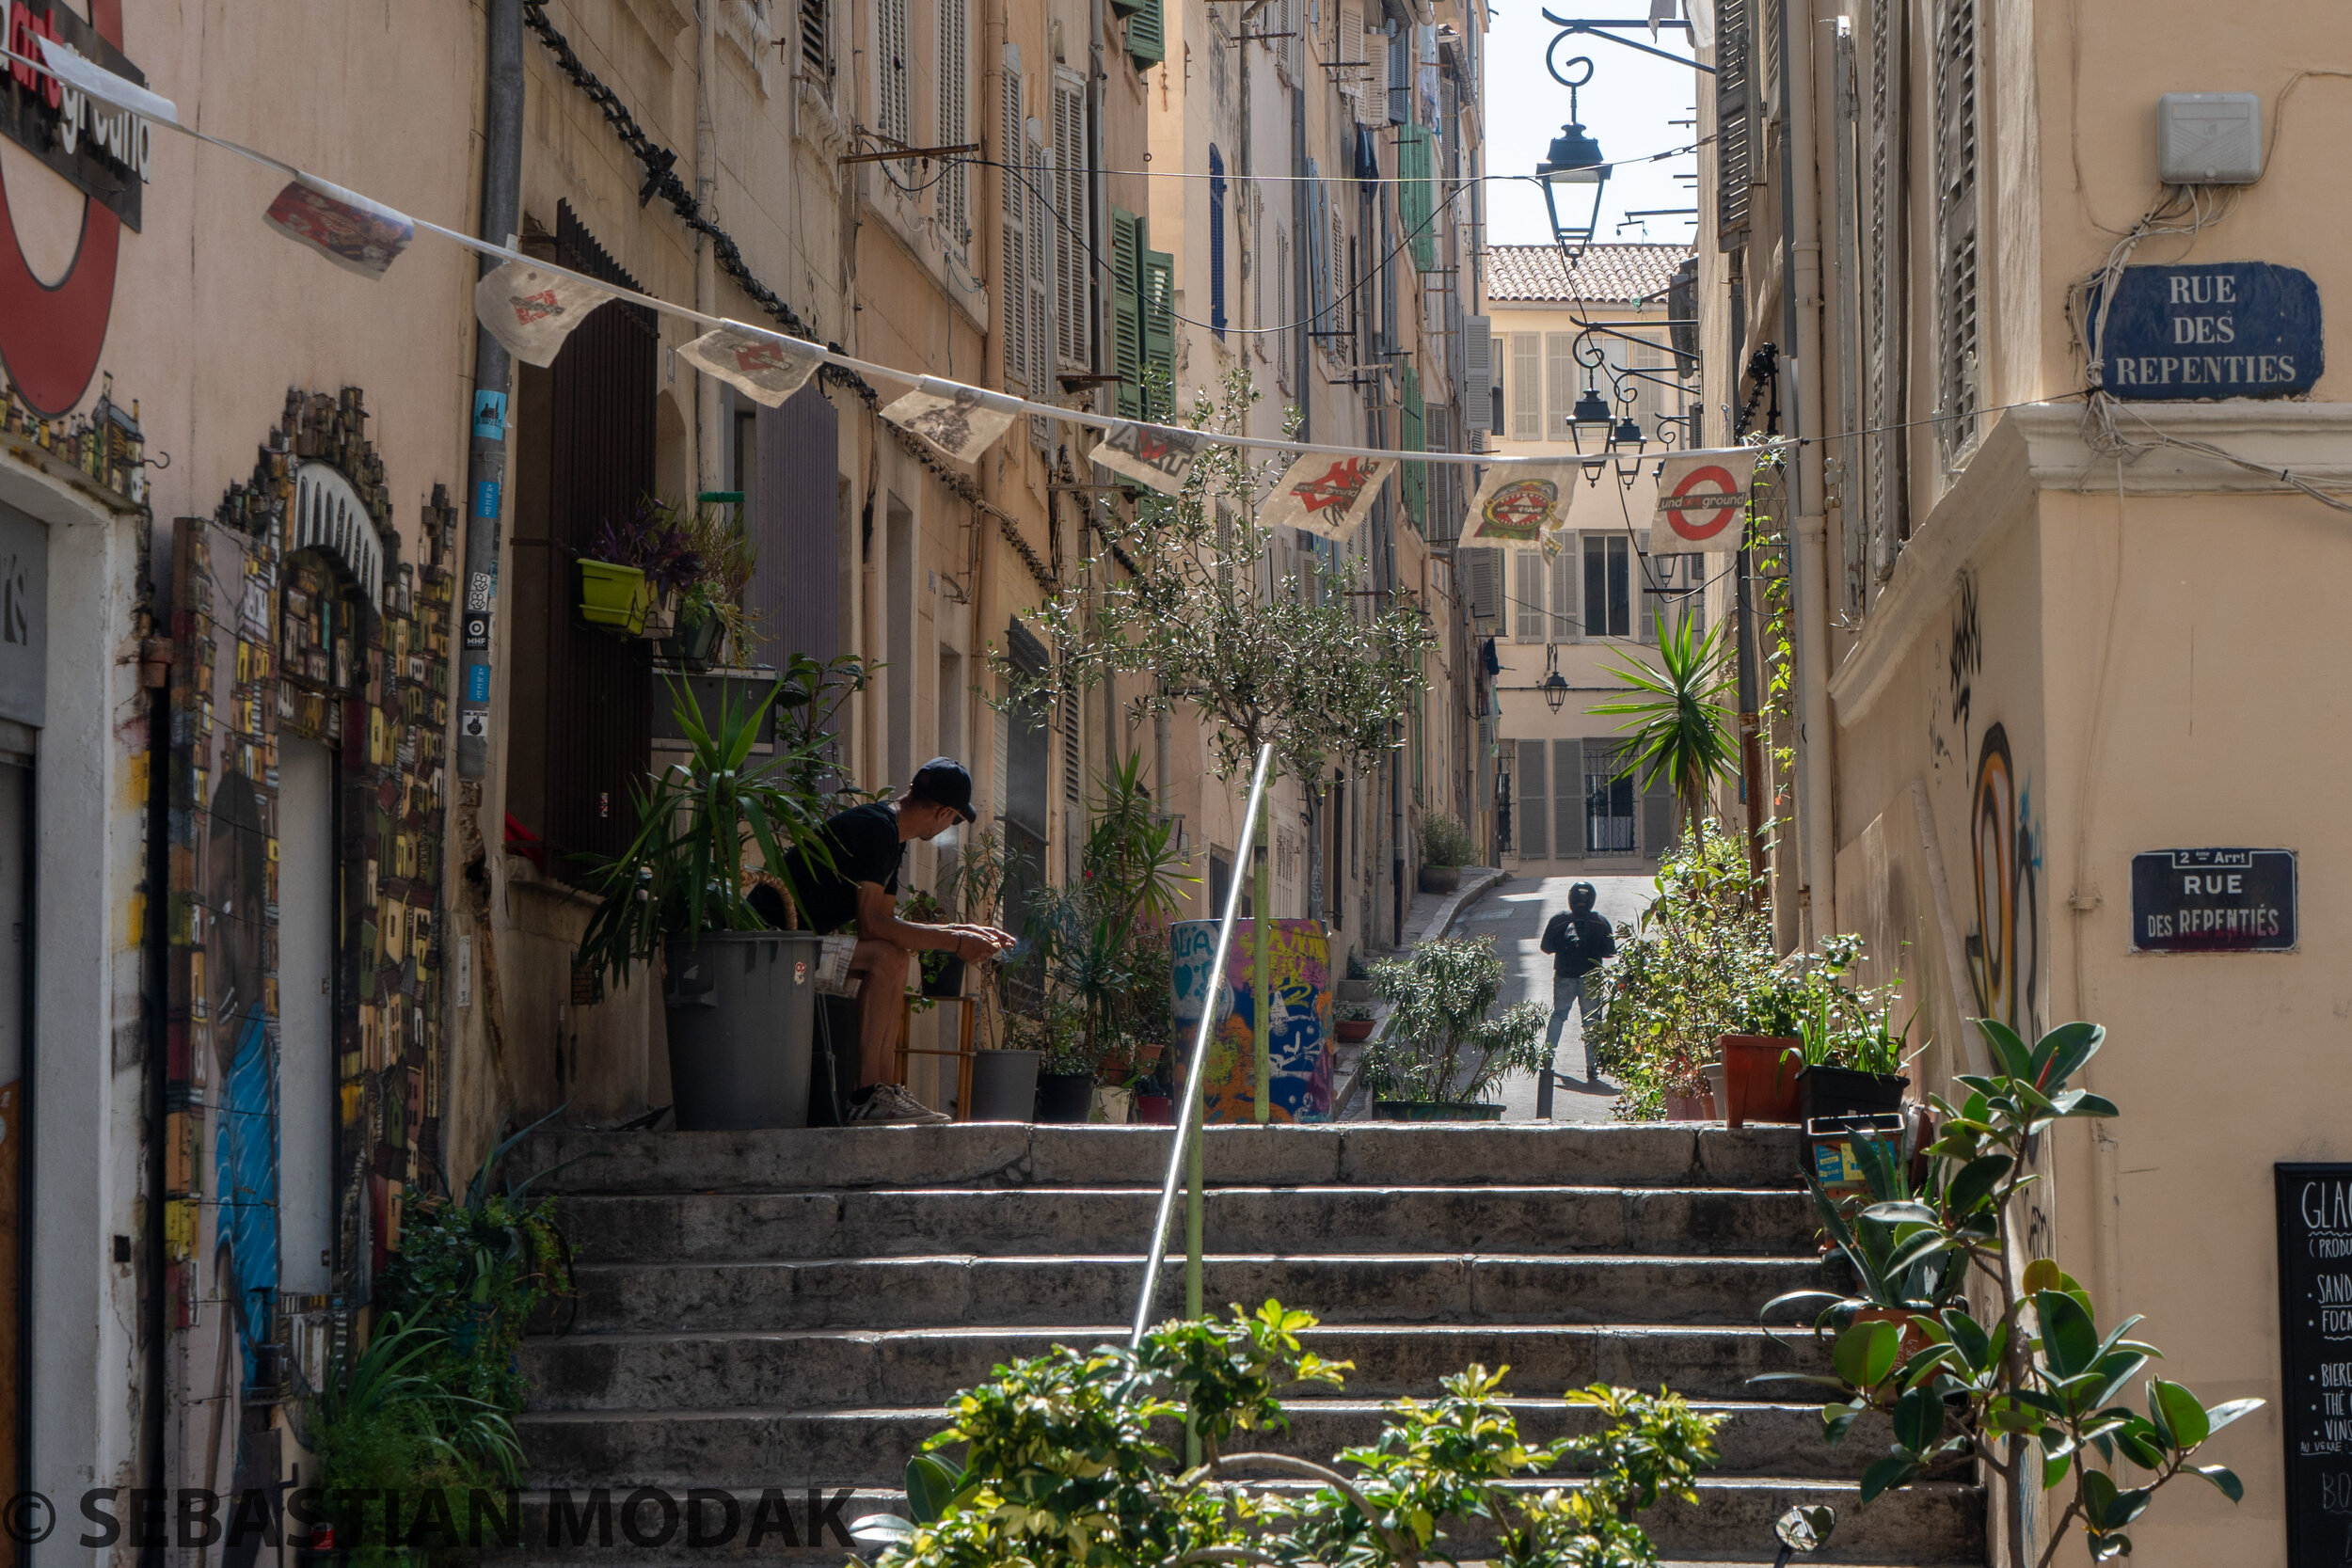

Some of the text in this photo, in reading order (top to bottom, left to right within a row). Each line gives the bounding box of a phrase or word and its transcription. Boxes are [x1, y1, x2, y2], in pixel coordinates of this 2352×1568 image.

[2169, 275, 2236, 304] RUE
[2173, 316, 2235, 344] DES
[2116, 355, 2296, 385] REPENTIES
[467, 637, 486, 645] MHF
[2180, 851, 2190, 863] 2
[2184, 875, 2243, 895] RUE
[2147, 914, 2173, 938] DES
[2317, 1273, 2352, 1304] SAND
